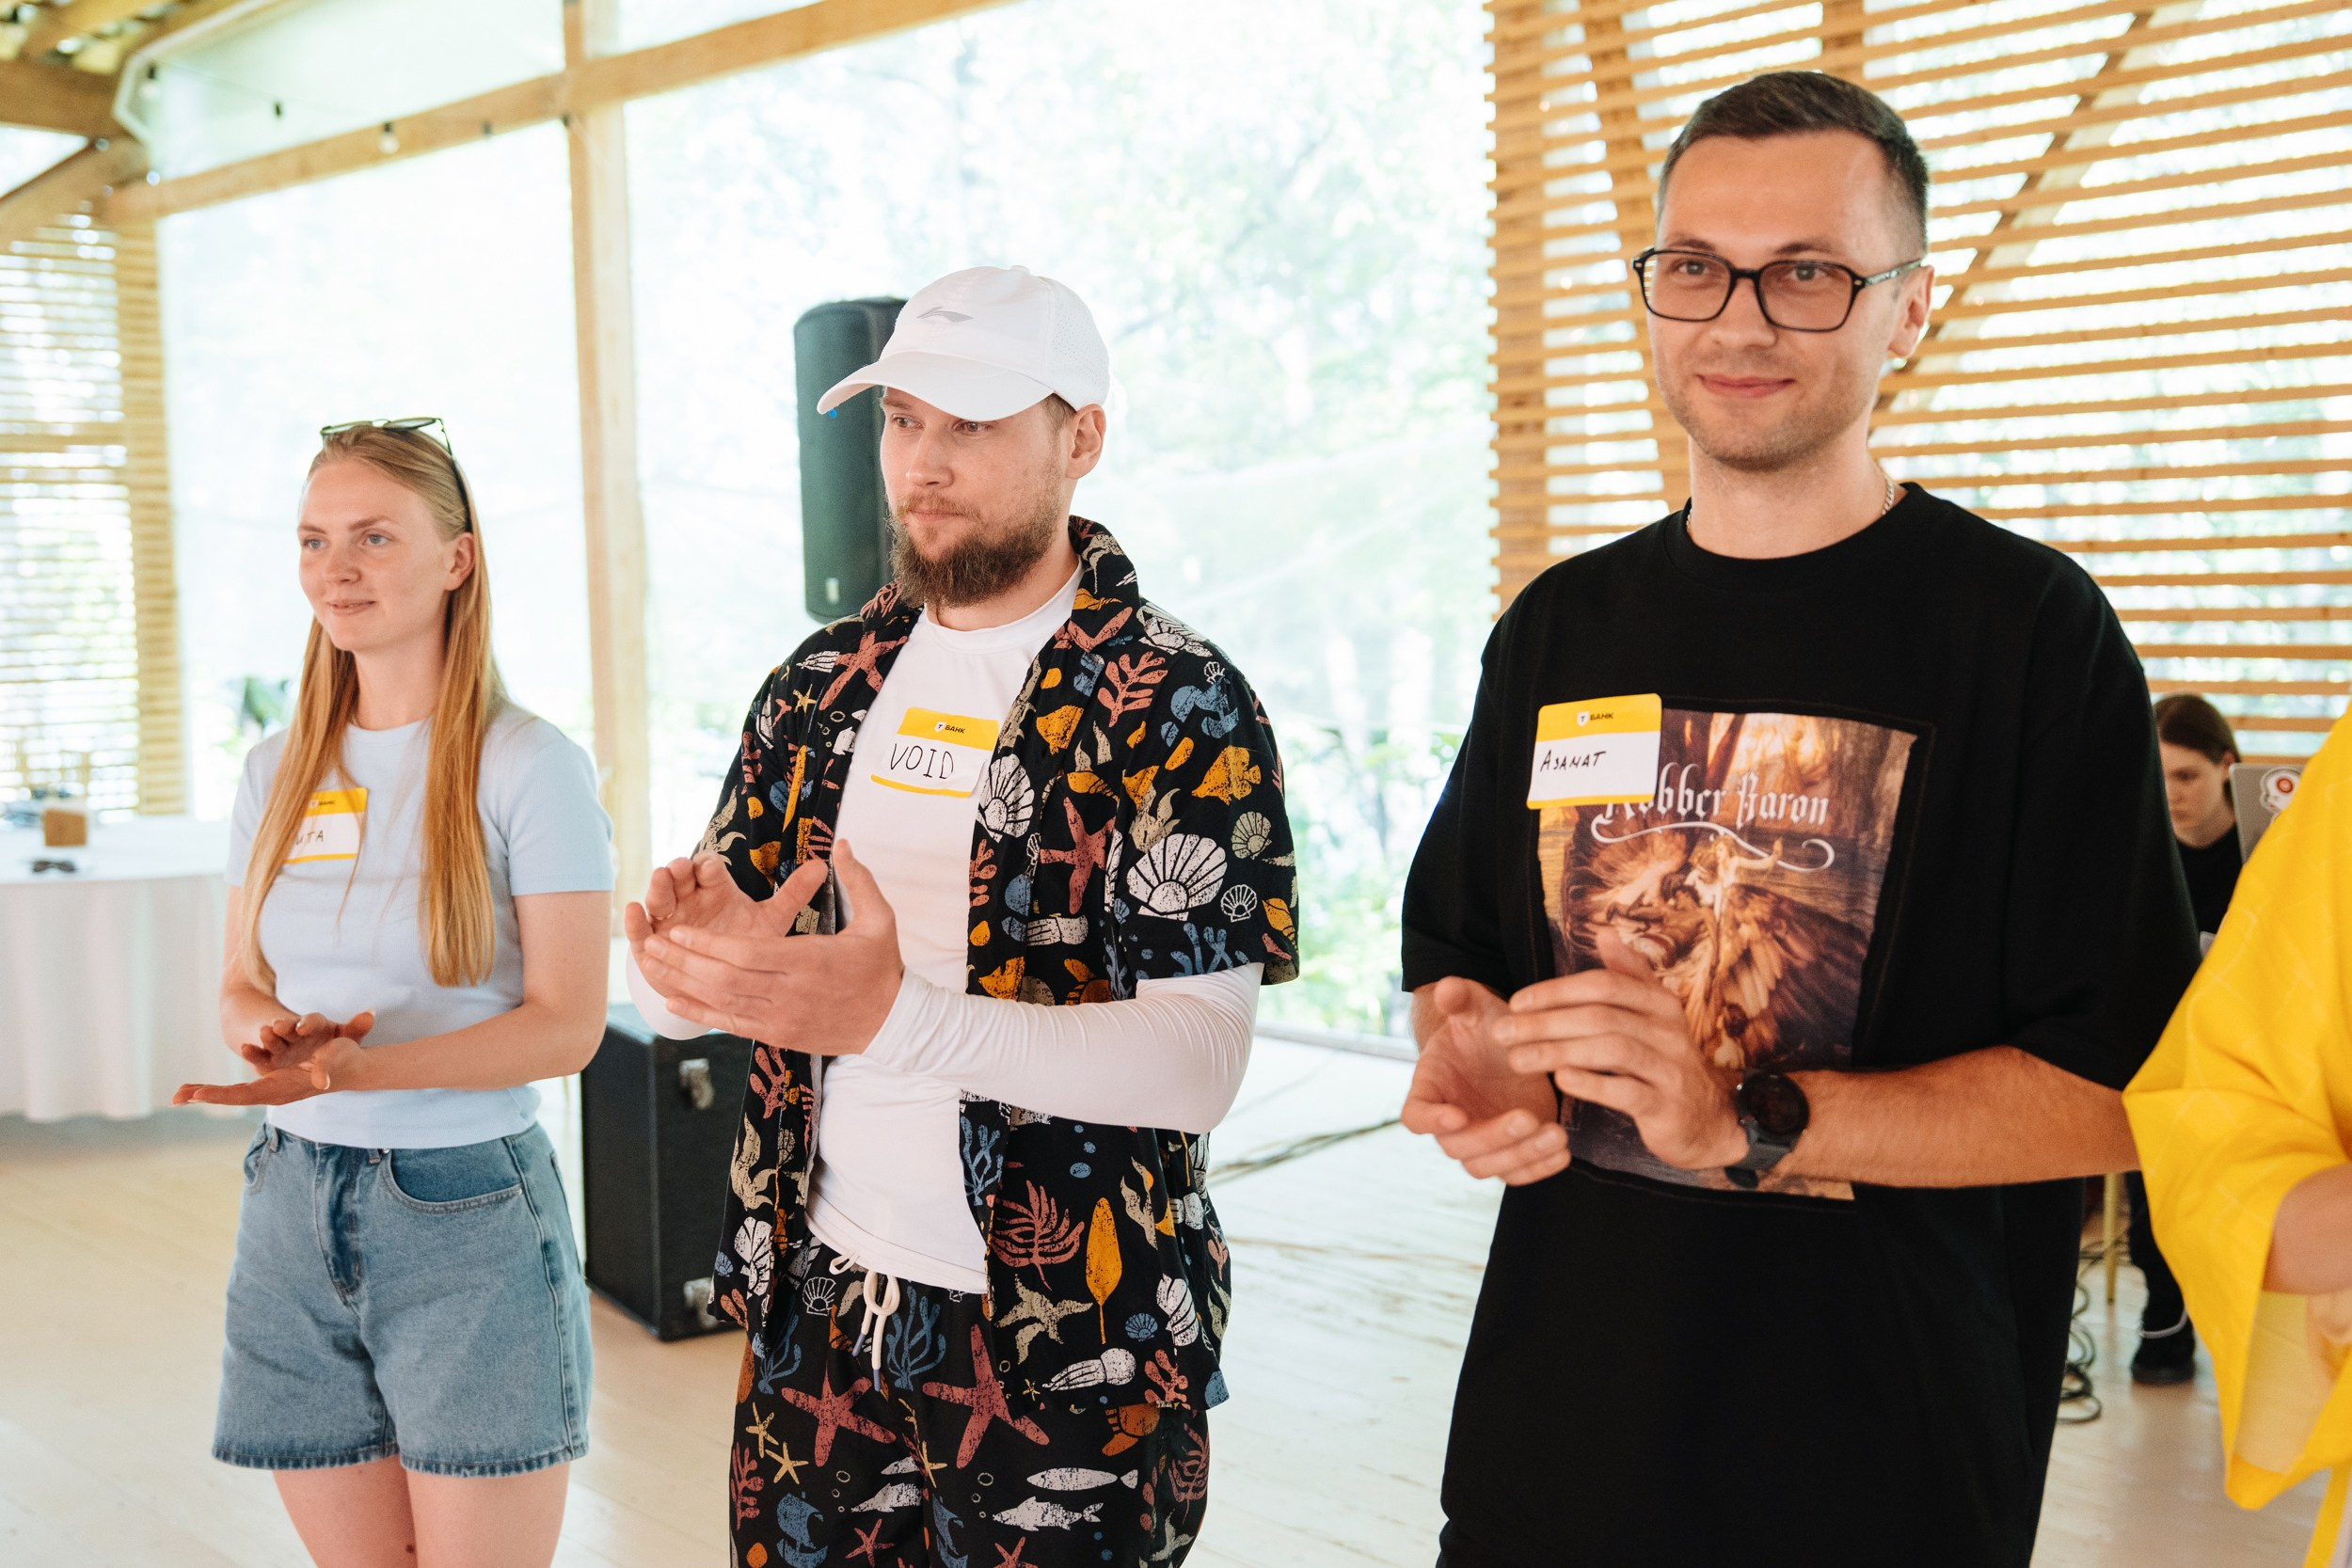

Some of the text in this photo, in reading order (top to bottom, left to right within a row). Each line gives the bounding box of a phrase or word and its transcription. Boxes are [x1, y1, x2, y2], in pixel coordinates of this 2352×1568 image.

[1589, 712, 1614, 721] БАНК
[945, 724, 966, 734] БАНК
[890, 742, 954, 780] VOID
[1735, 769, 1830, 831] Baron
